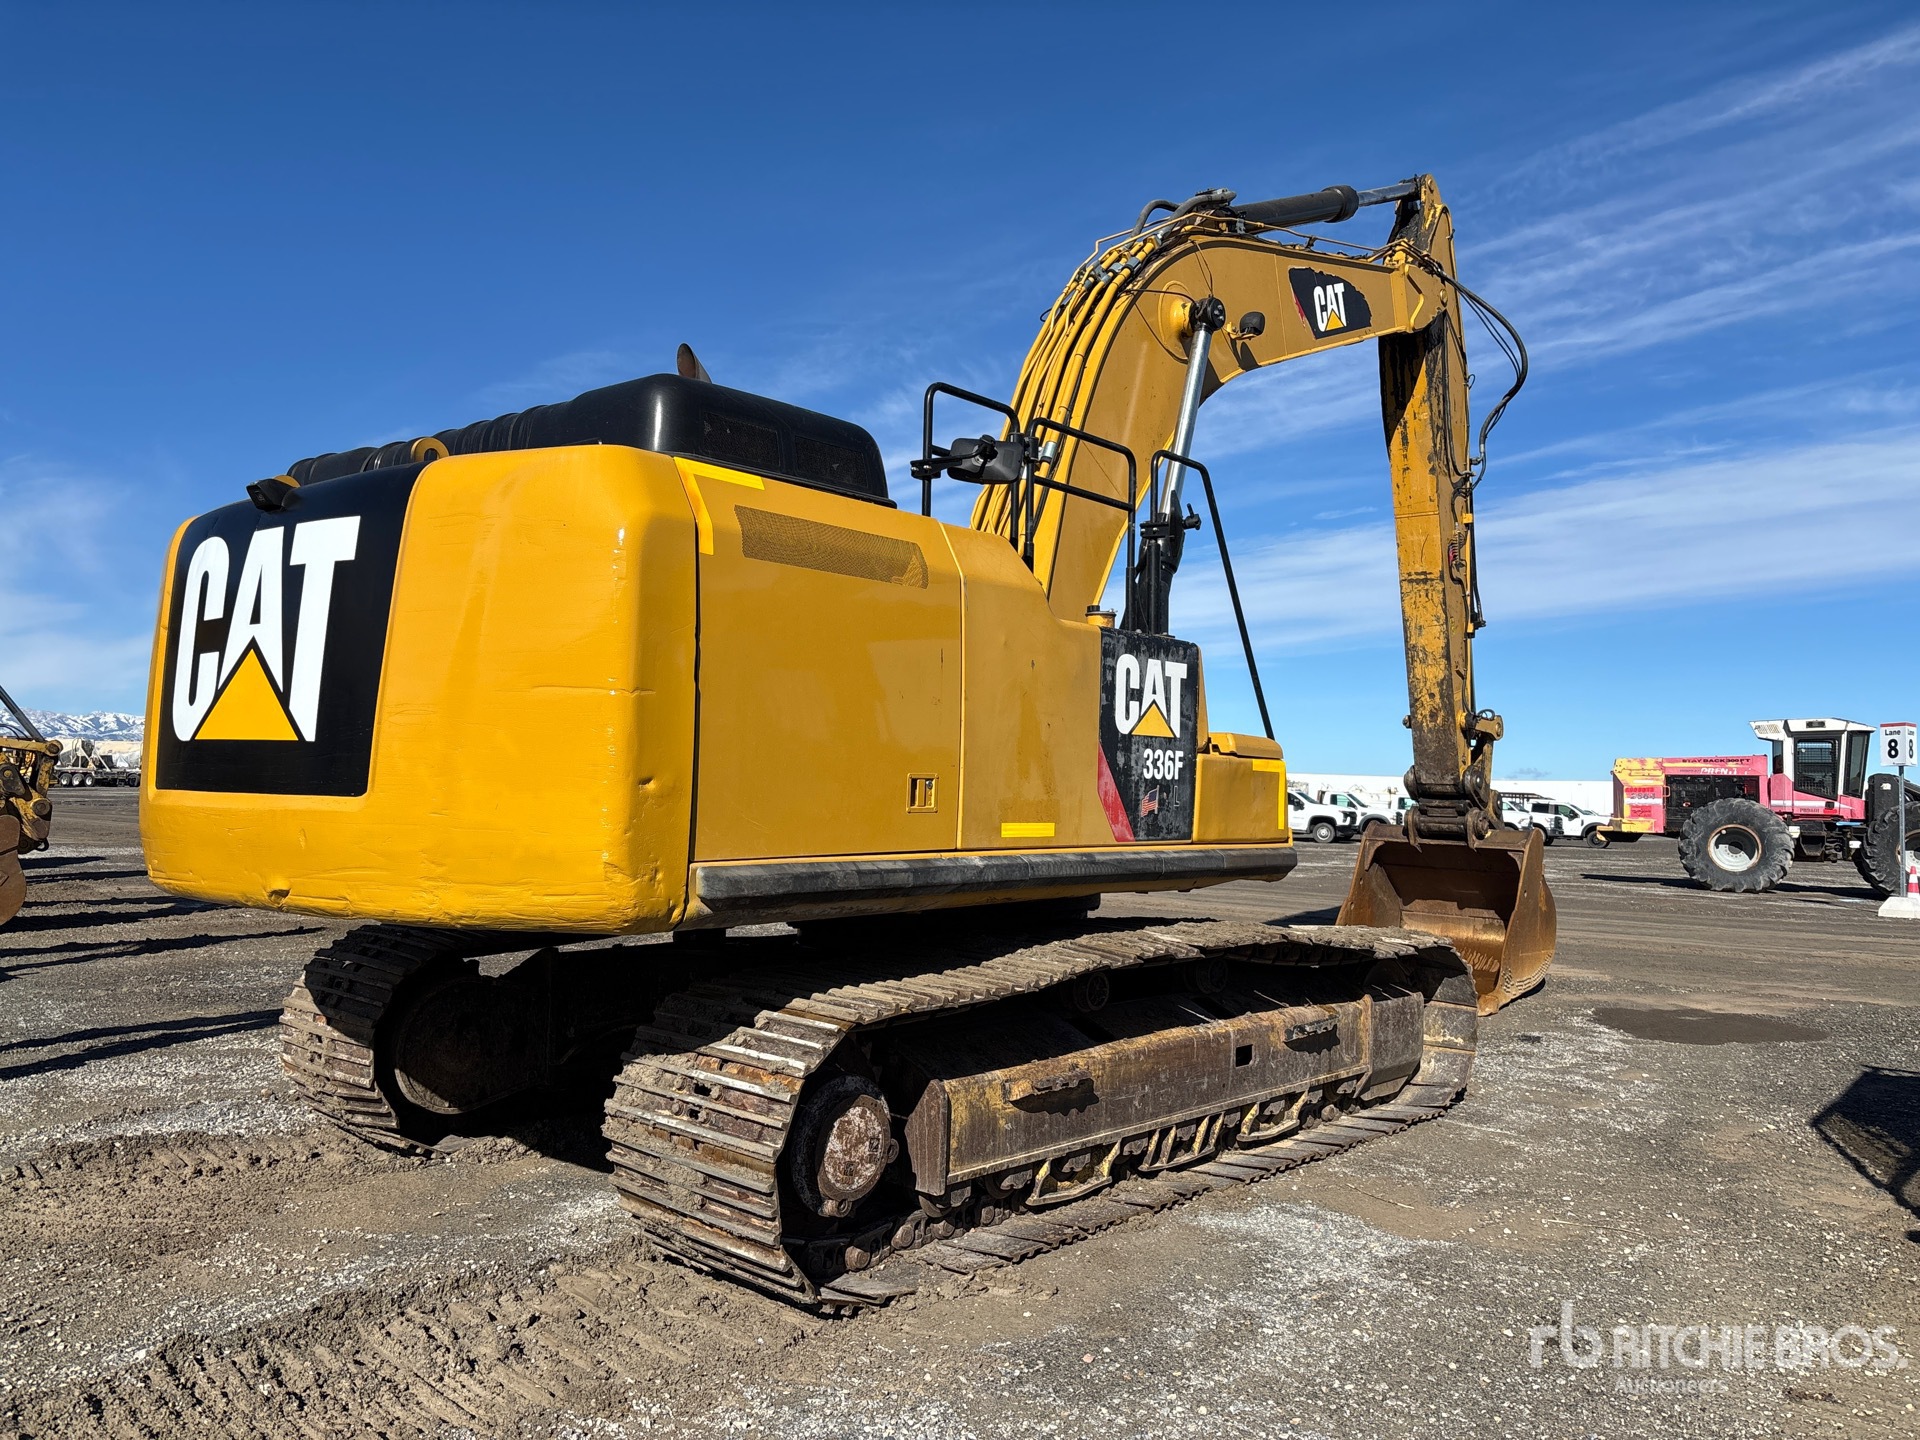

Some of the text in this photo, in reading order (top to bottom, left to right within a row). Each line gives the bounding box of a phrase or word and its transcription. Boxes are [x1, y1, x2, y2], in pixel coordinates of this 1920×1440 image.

[1313, 282, 1347, 332] CAT
[173, 515, 361, 742] CAT
[1114, 653, 1188, 738] CAT
[1143, 748, 1184, 780] 336F
[1887, 738, 1899, 759] 8
[1908, 738, 1914, 759] 8
